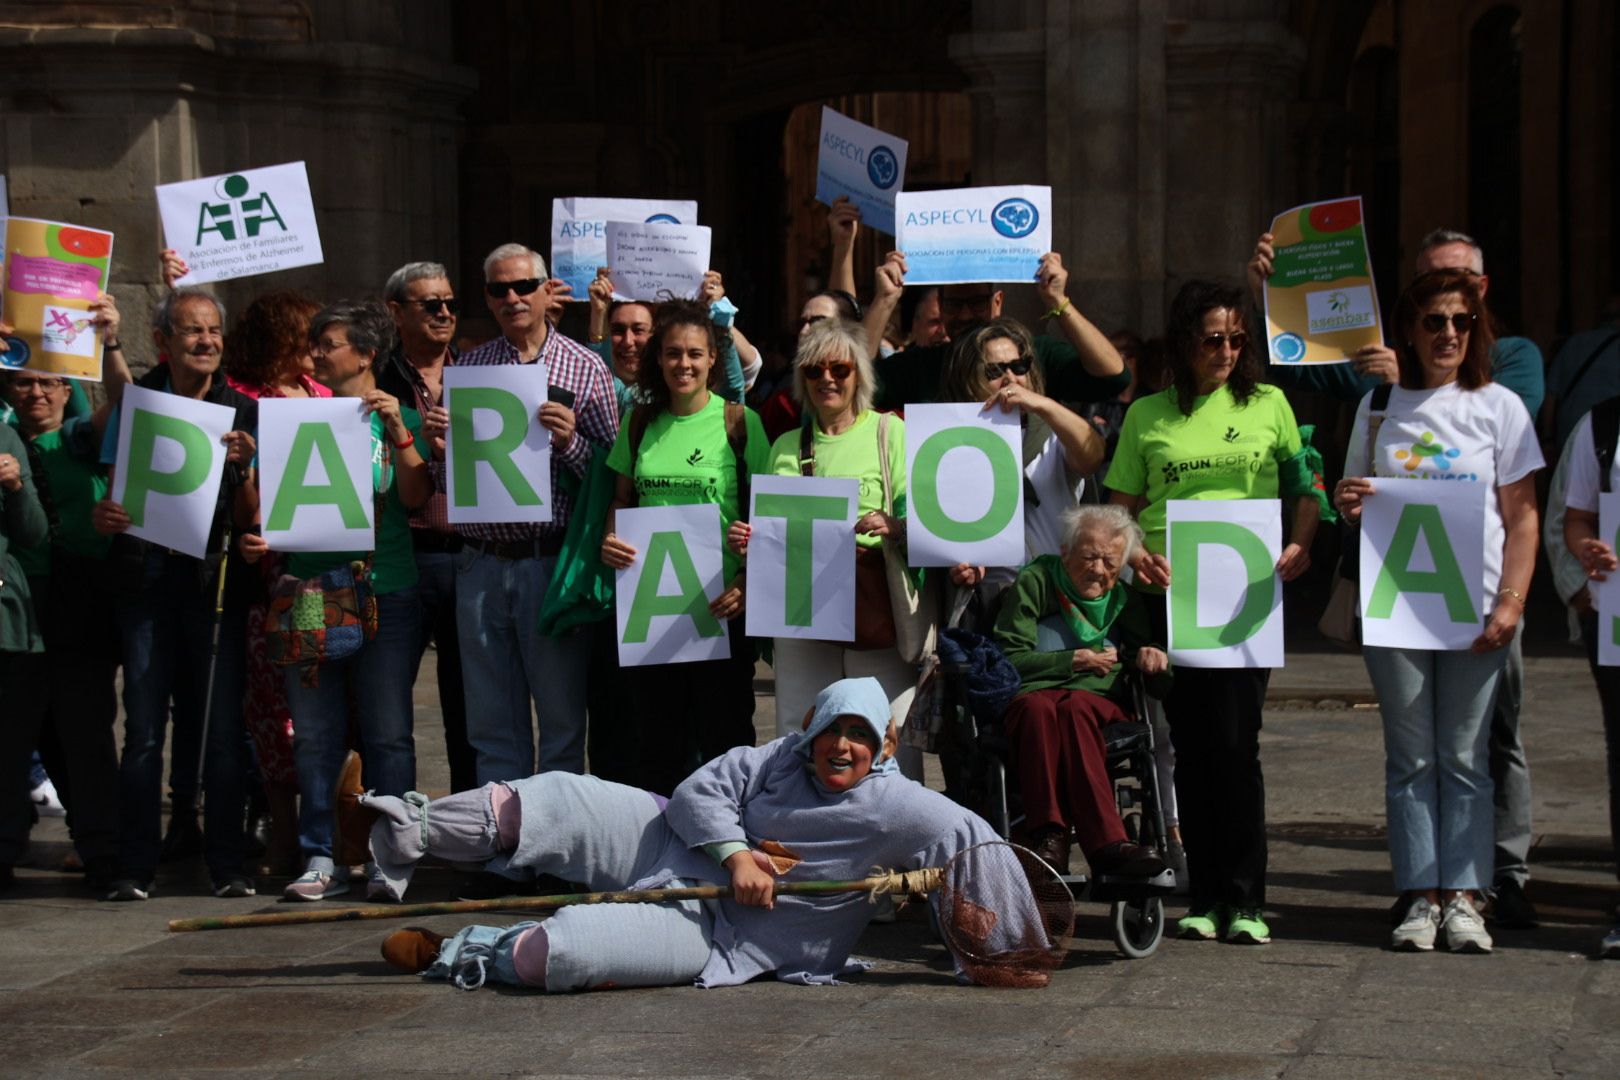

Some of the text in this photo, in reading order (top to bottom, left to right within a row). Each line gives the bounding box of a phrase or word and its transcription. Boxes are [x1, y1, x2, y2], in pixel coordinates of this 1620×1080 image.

[823, 131, 865, 166] ASPECYL
[560, 221, 607, 238] ASPE
[905, 208, 988, 227] ASPECYL
[201, 257, 242, 271] Enfermos
[246, 253, 257, 262] de
[260, 245, 304, 258] Alzheimer
[240, 242, 251, 252] de
[254, 234, 298, 248] Familiares
[231, 262, 279, 276] Salamanca
[1311, 311, 1371, 328] asenbar
[450, 387, 543, 507] R
[1180, 454, 1248, 472] RUN FOR
[123, 408, 213, 528] P
[265, 421, 369, 532] A
[644, 478, 702, 489] RUN FOR
[911, 426, 1021, 543] O
[754, 492, 849, 627] T
[1365, 504, 1478, 624] A
[623, 531, 725, 644] A
[1169, 520, 1276, 650] D
